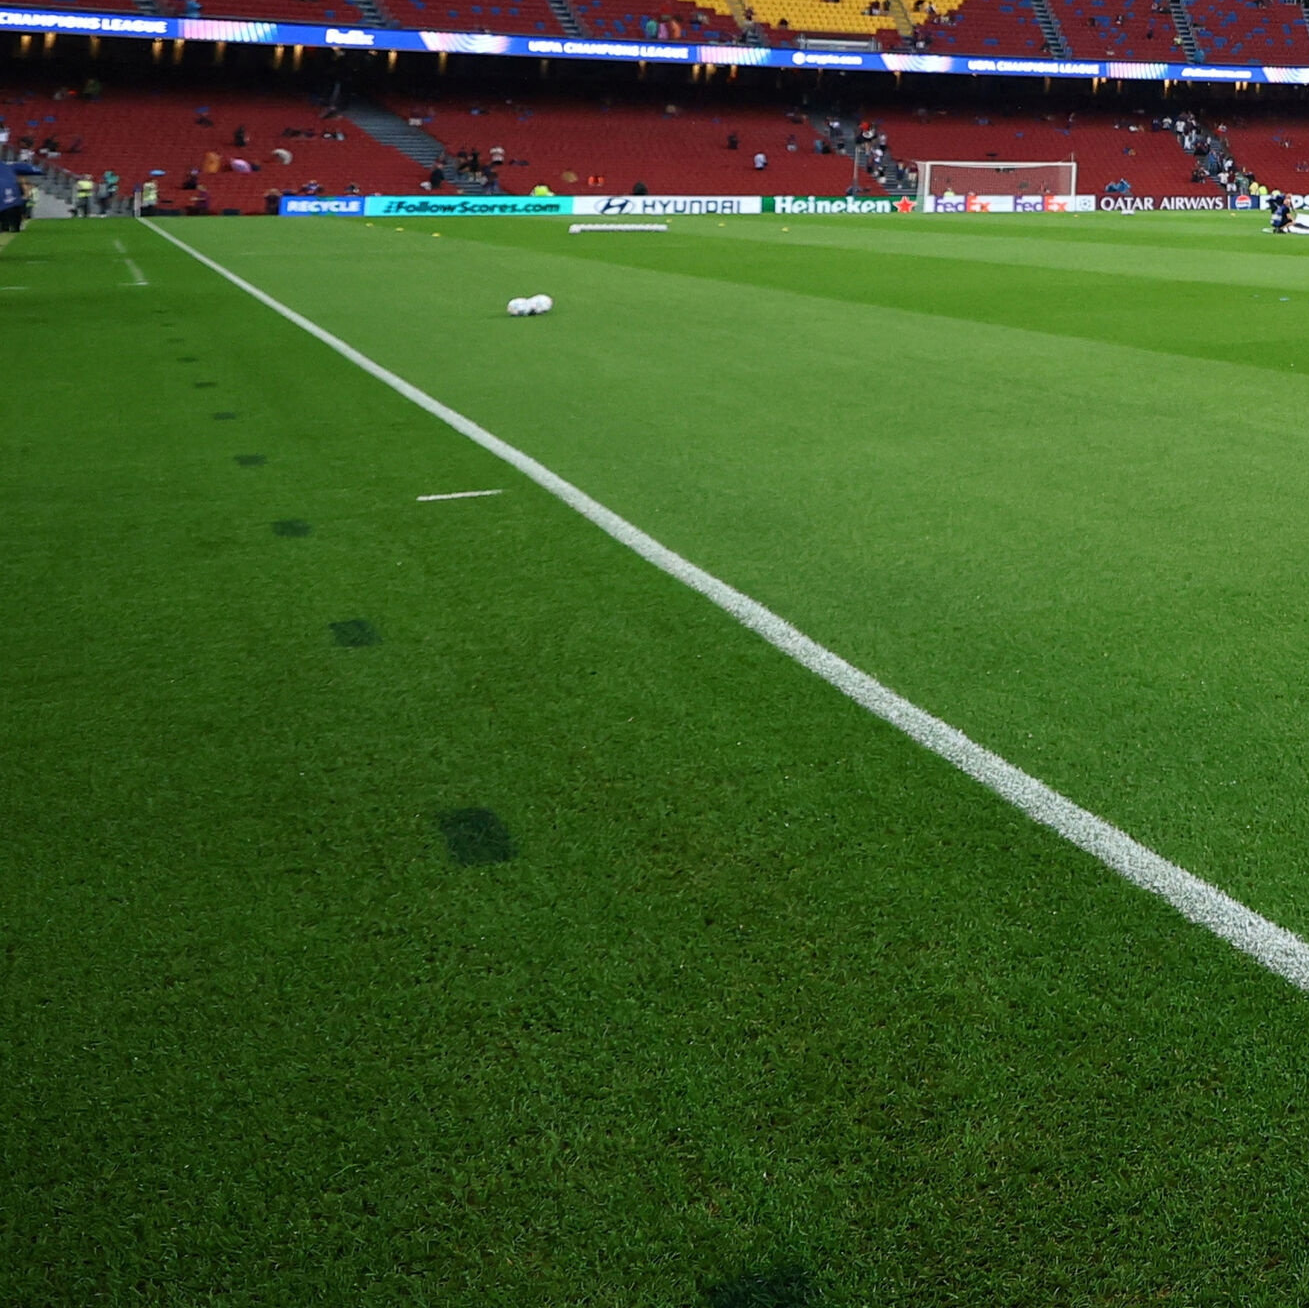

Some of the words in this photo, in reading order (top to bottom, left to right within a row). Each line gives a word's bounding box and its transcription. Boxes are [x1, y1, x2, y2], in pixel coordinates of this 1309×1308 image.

[101, 18, 168, 34] LEAGUE
[640, 45, 689, 59] LEAGUE
[287, 199, 361, 213] RECYCLE
[642, 199, 742, 213] HYUNDAI
[773, 196, 891, 214] Heineken
[934, 196, 991, 212] FedEx
[1012, 196, 1069, 212] FedEx
[1100, 197, 1154, 211] QATAR
[1160, 196, 1224, 210] AIRWAYS
